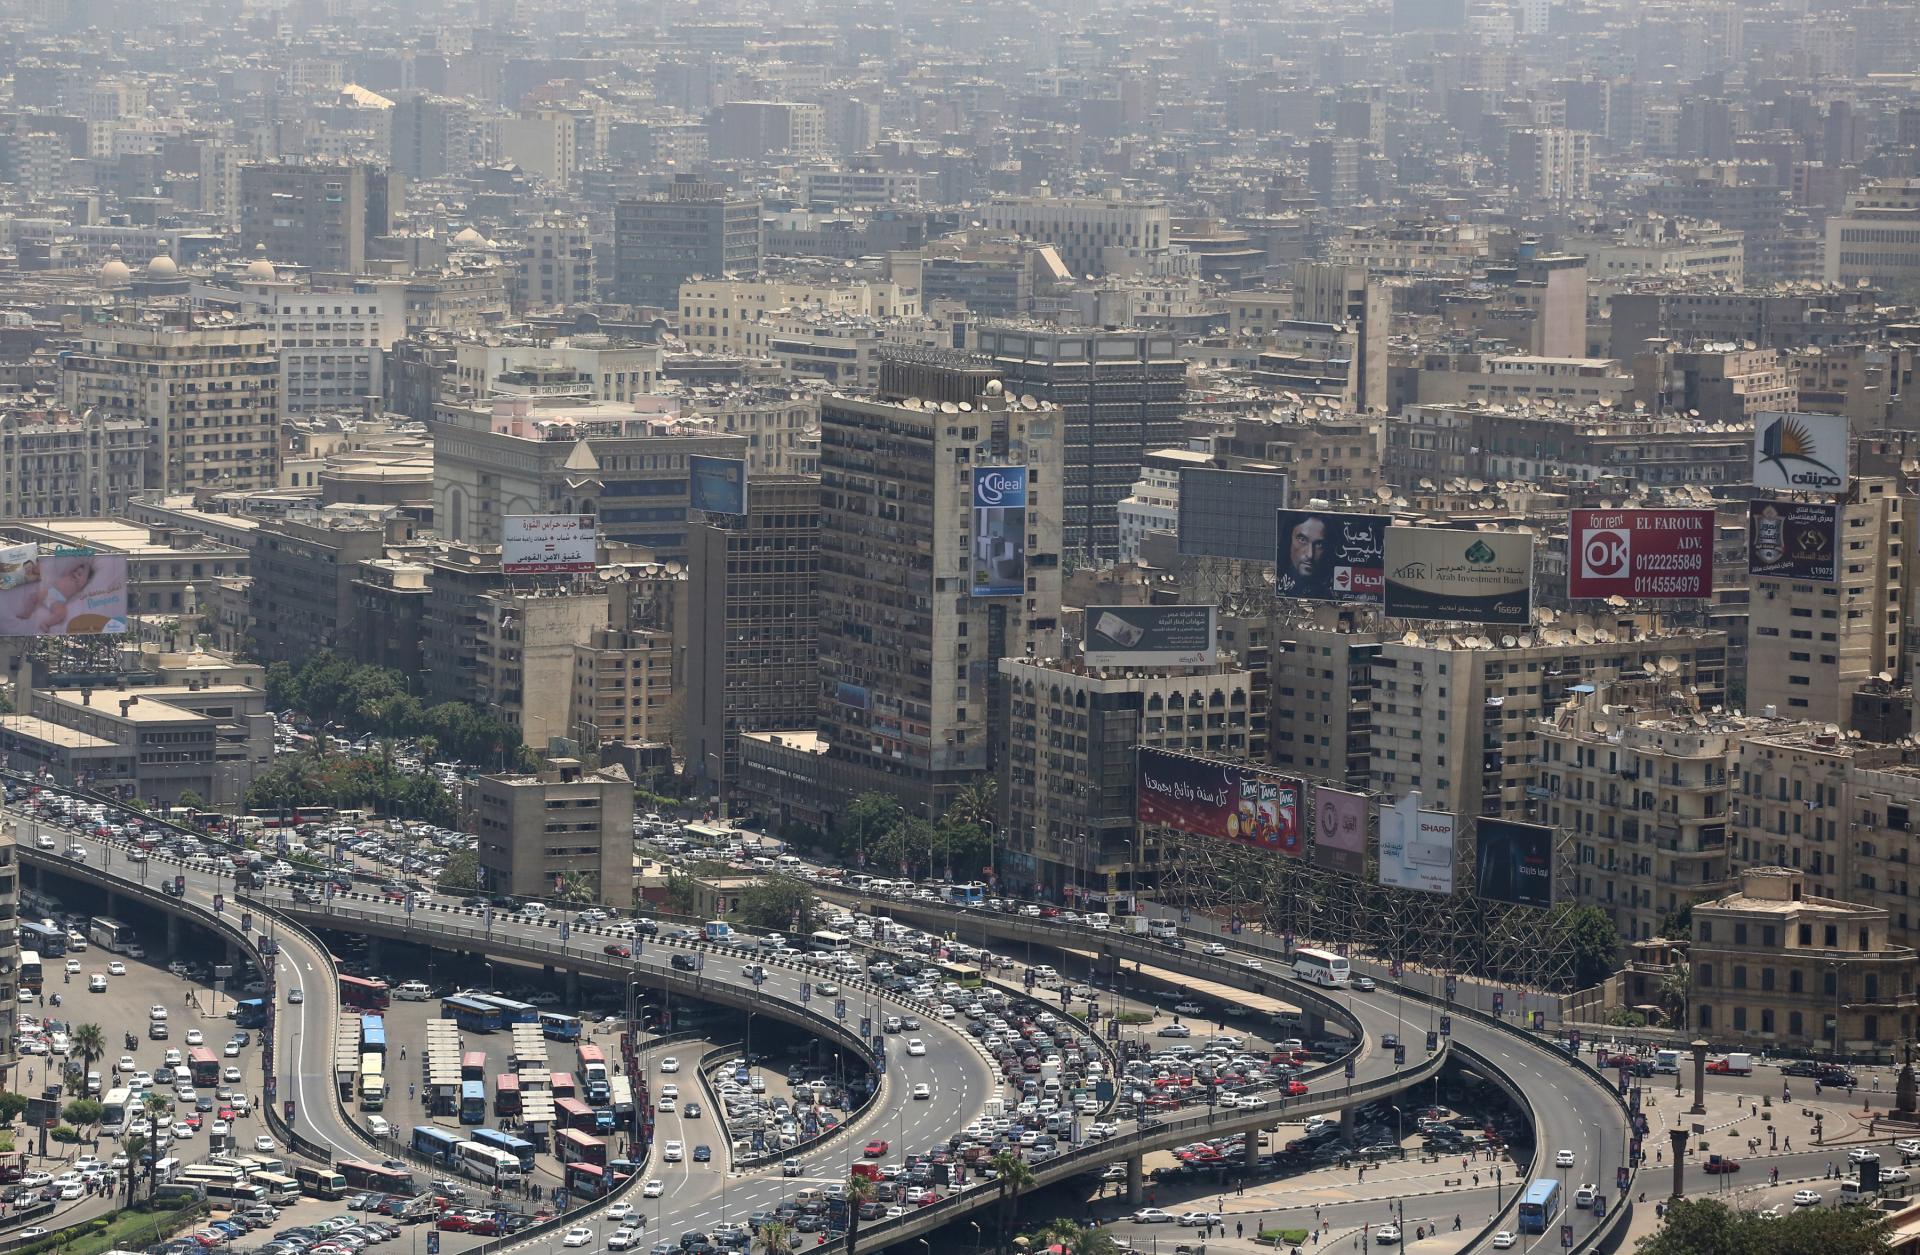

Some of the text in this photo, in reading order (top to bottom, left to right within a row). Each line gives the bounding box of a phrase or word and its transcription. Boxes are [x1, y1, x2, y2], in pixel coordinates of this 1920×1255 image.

[994, 475, 1022, 490] Ideal
[1590, 514, 1624, 529] for rent
[1636, 517, 1703, 530] EL FAROUK
[1343, 521, 1373, 545] لعبة
[1677, 536, 1703, 549] ADV.
[1586, 541, 1628, 566] OK
[1636, 554, 1701, 571] 01222255849
[1436, 573, 1524, 585] Arab Investment Bank
[1635, 576, 1700, 593] 01145554979
[1260, 785, 1277, 799] TANG
[1421, 823, 1451, 834] SHARP
